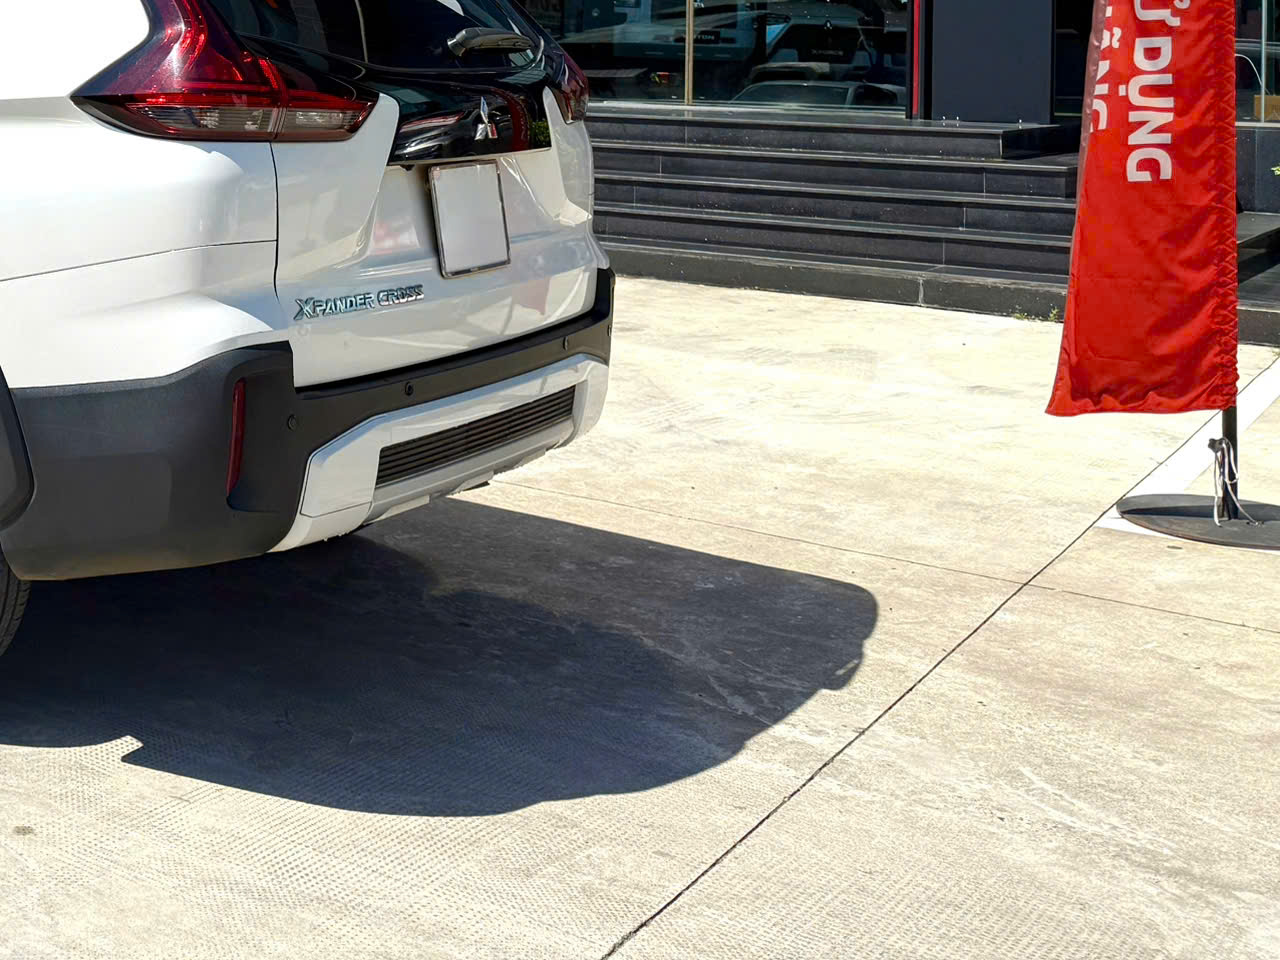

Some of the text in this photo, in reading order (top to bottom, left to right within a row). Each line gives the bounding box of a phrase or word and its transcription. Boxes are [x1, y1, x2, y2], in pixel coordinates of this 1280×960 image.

[1118, 36, 1175, 182] DỤNG
[293, 285, 425, 321] XPANDER CROSS
